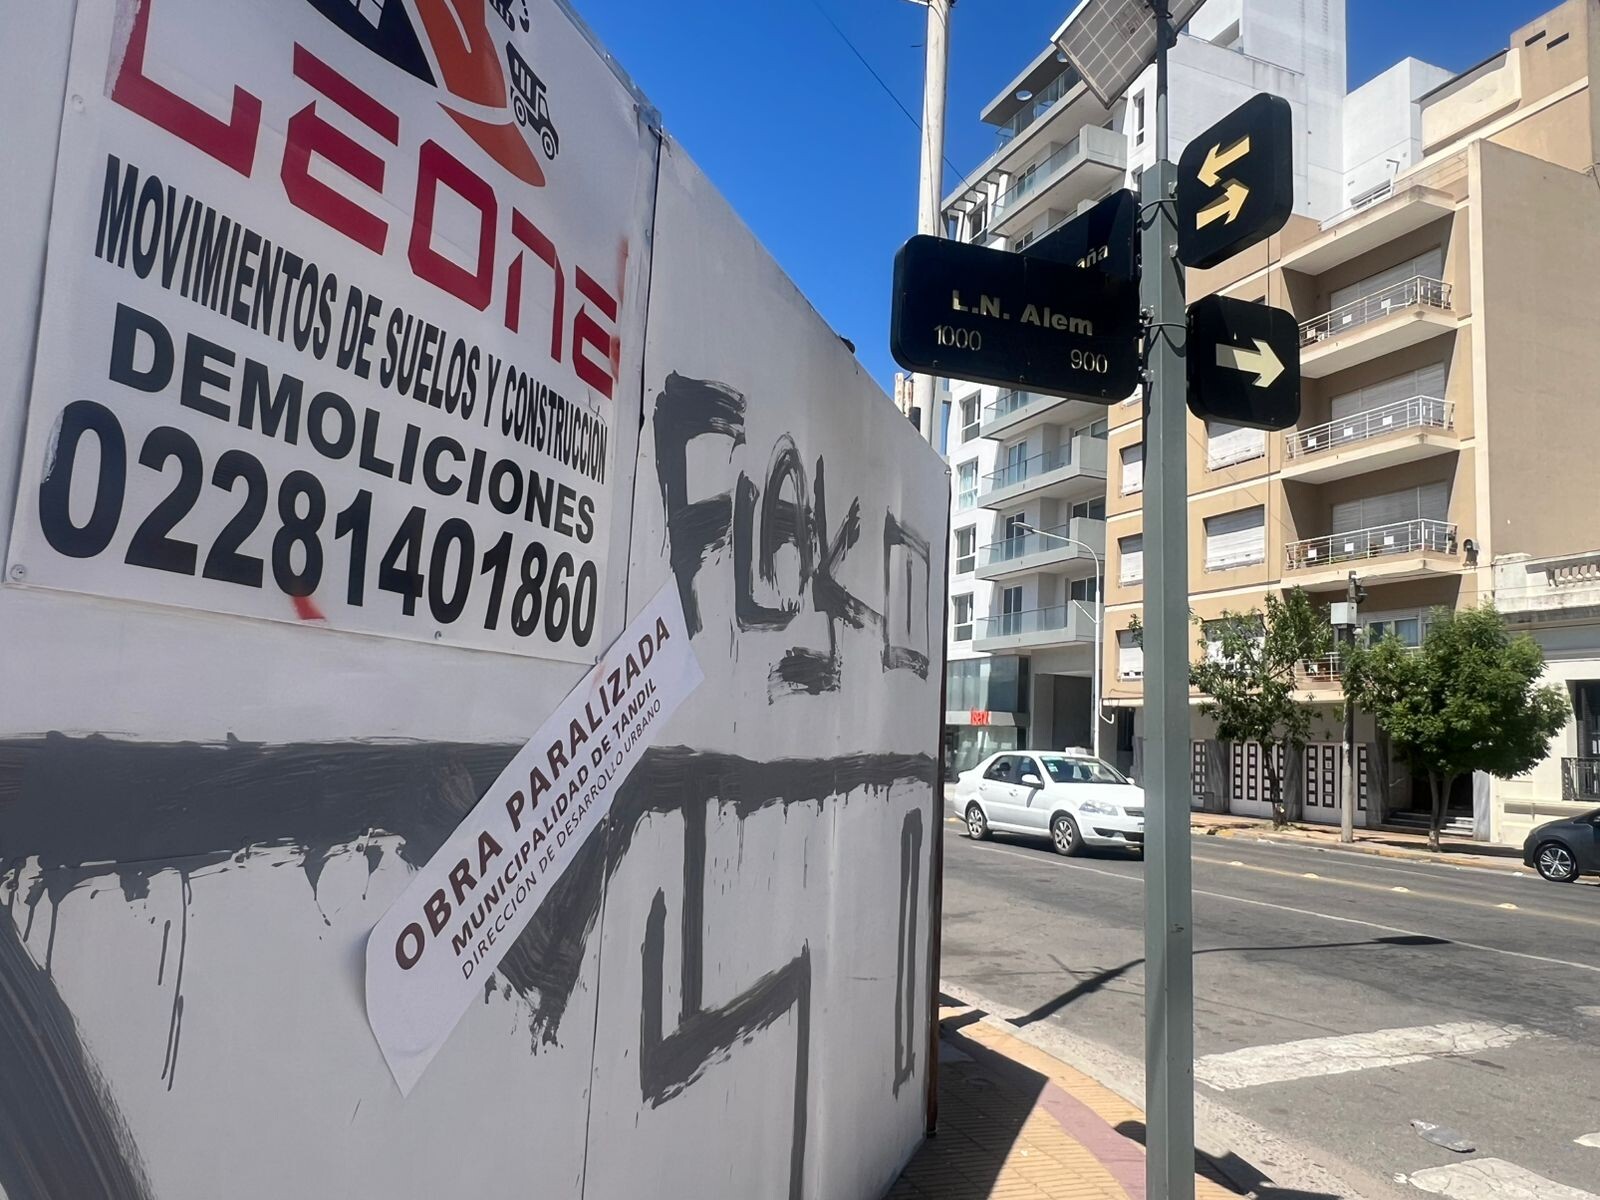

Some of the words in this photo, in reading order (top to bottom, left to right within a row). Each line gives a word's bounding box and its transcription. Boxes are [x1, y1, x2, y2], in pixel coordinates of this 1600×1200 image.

[94, 153, 337, 361] MOVIMIENTOS
[335, 285, 383, 380] DE
[379, 307, 481, 421] SUELOS
[483, 353, 502, 428] Y
[500, 364, 608, 486] CONSTRUCCIÓN
[933, 324, 983, 352] 1000
[1070, 349, 1109, 375] 900
[952, 289, 1010, 320] L.N.
[1019, 303, 1094, 337] Alem
[1075, 245, 1109, 269] aña
[38, 399, 599, 648] 02281401860
[108, 302, 595, 545] DEMOLICIONES
[394, 832, 504, 972] OBRA
[505, 615, 671, 834] PARALIZADA
[450, 764, 590, 957] MUNICIPALIDAD
[590, 734, 612, 769] DE
[611, 678, 658, 740] TANDIL
[461, 873, 538, 980] DIRECCIÓN
[538, 845, 556, 875] DE
[555, 750, 624, 849] DESARROLLO
[623, 698, 662, 754] URBANO
